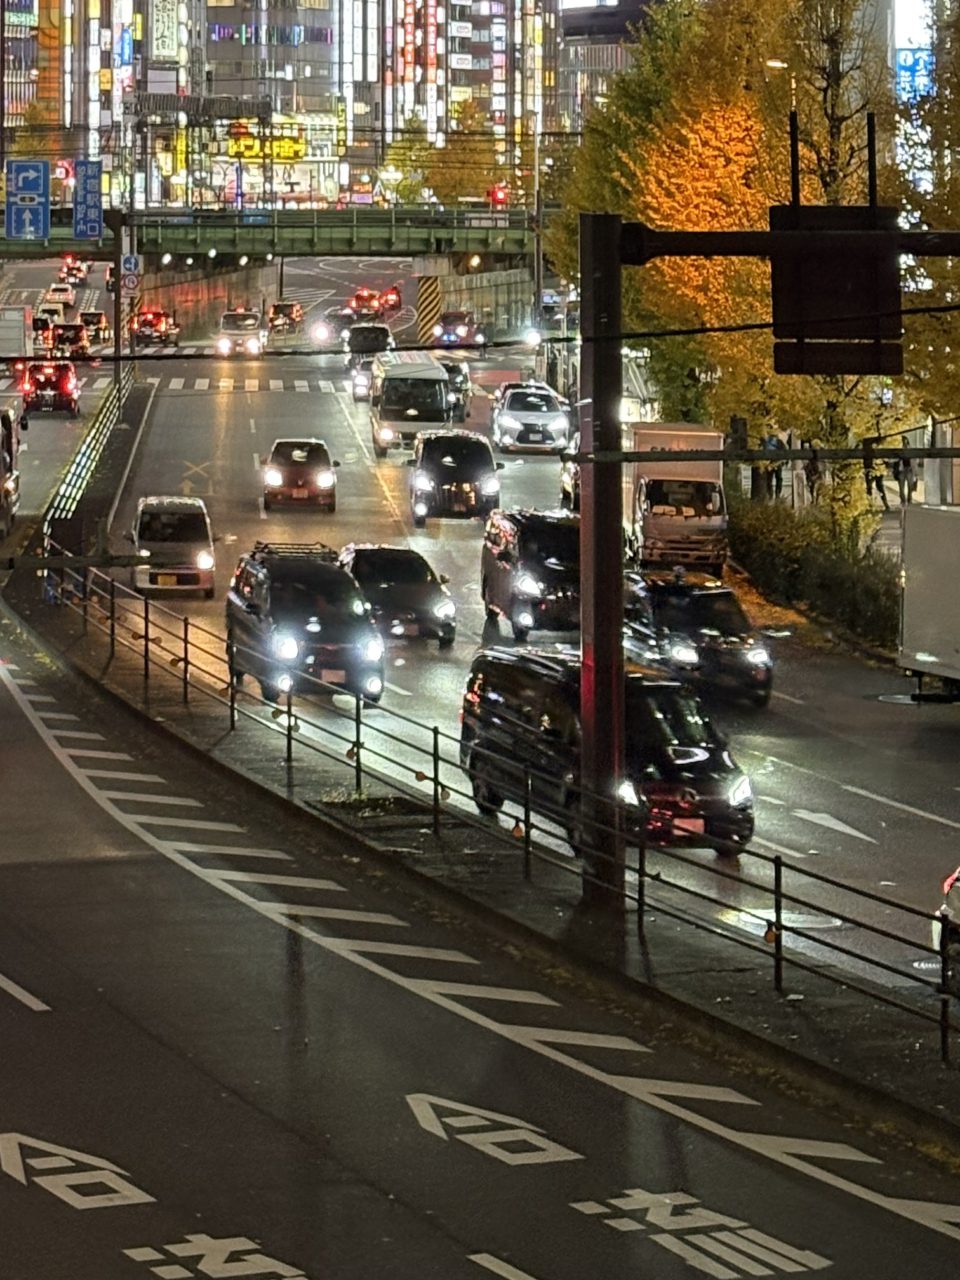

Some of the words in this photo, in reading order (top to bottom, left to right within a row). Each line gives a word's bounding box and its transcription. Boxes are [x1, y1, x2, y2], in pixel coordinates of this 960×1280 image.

[86, 163, 99, 236] 新宿駅東口
